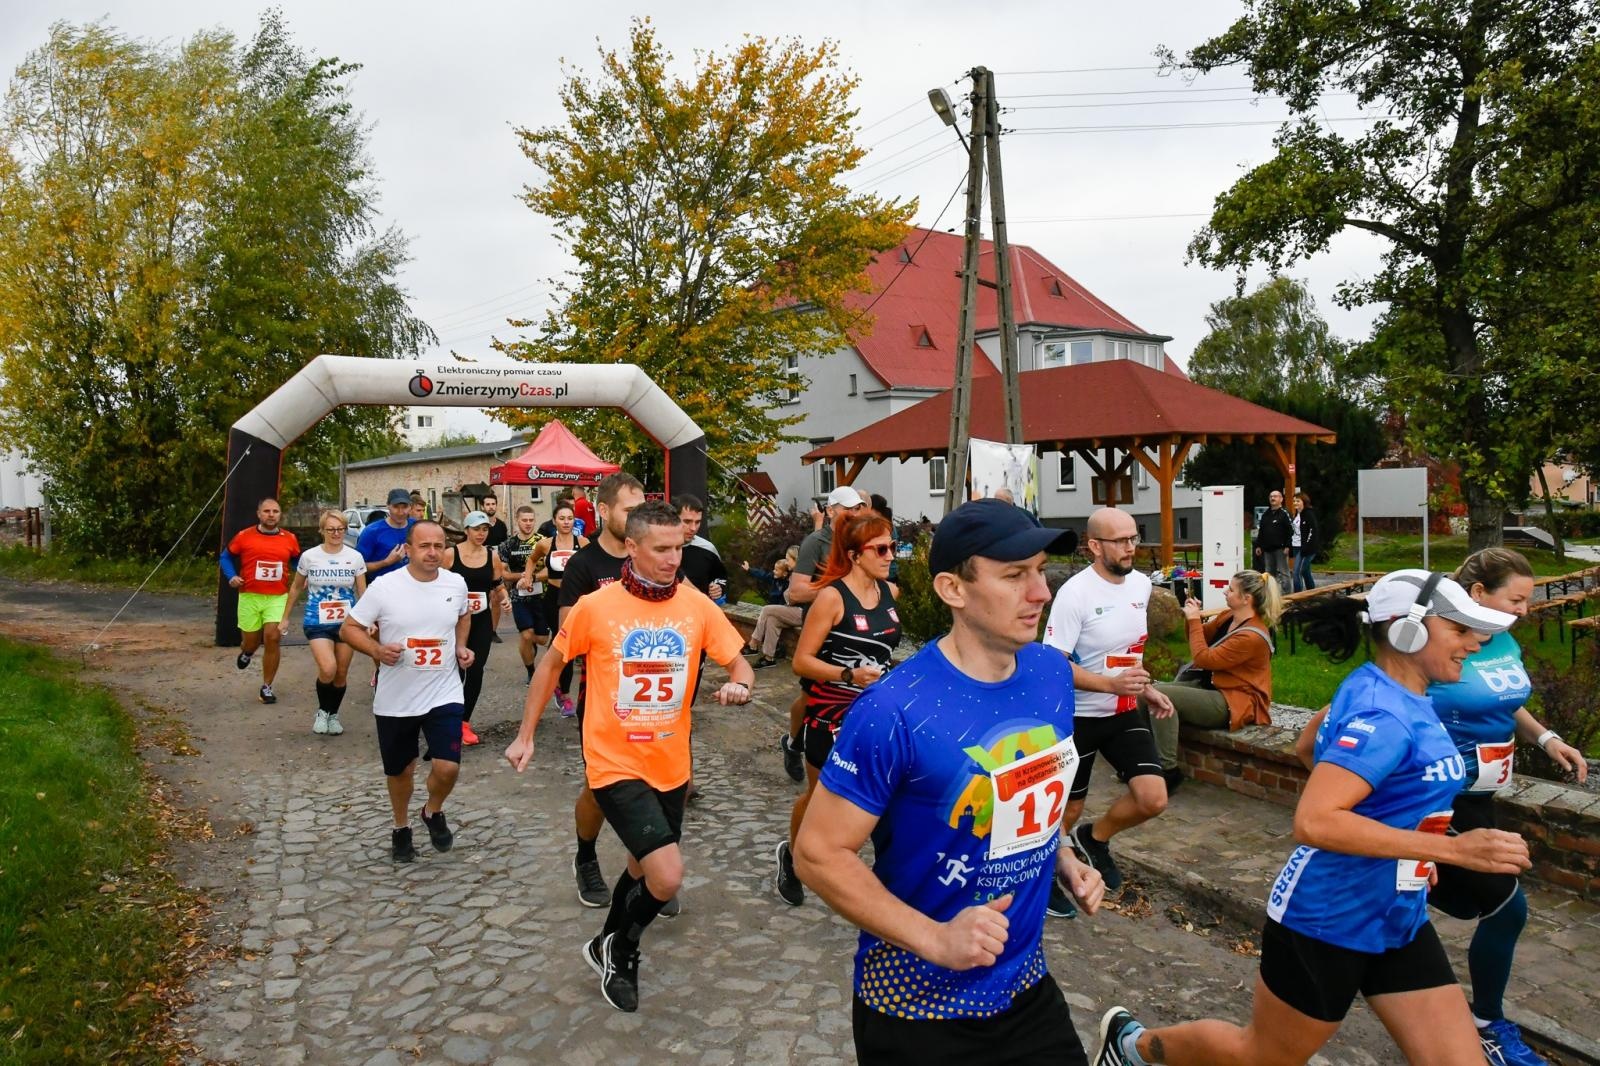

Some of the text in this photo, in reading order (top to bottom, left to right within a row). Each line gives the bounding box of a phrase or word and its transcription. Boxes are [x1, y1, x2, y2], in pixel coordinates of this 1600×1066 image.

[437, 365, 500, 377] Elektroniczny
[499, 367, 535, 377] pomiar
[436, 381, 568, 399] ZmierzymyCzas.pl
[261, 568, 277, 578] 31
[309, 568, 356, 577] RUNNERS
[326, 608, 345, 620] 22
[414, 648, 442, 666] 32
[633, 676, 674, 702] 25
[1017, 756, 1075, 788] na dystansie 10 km
[1022, 755, 1062, 775] Krzanowicki
[1496, 759, 1510, 784] 3
[1016, 780, 1064, 838] 12
[980, 857, 1028, 875] RYBNICKI
